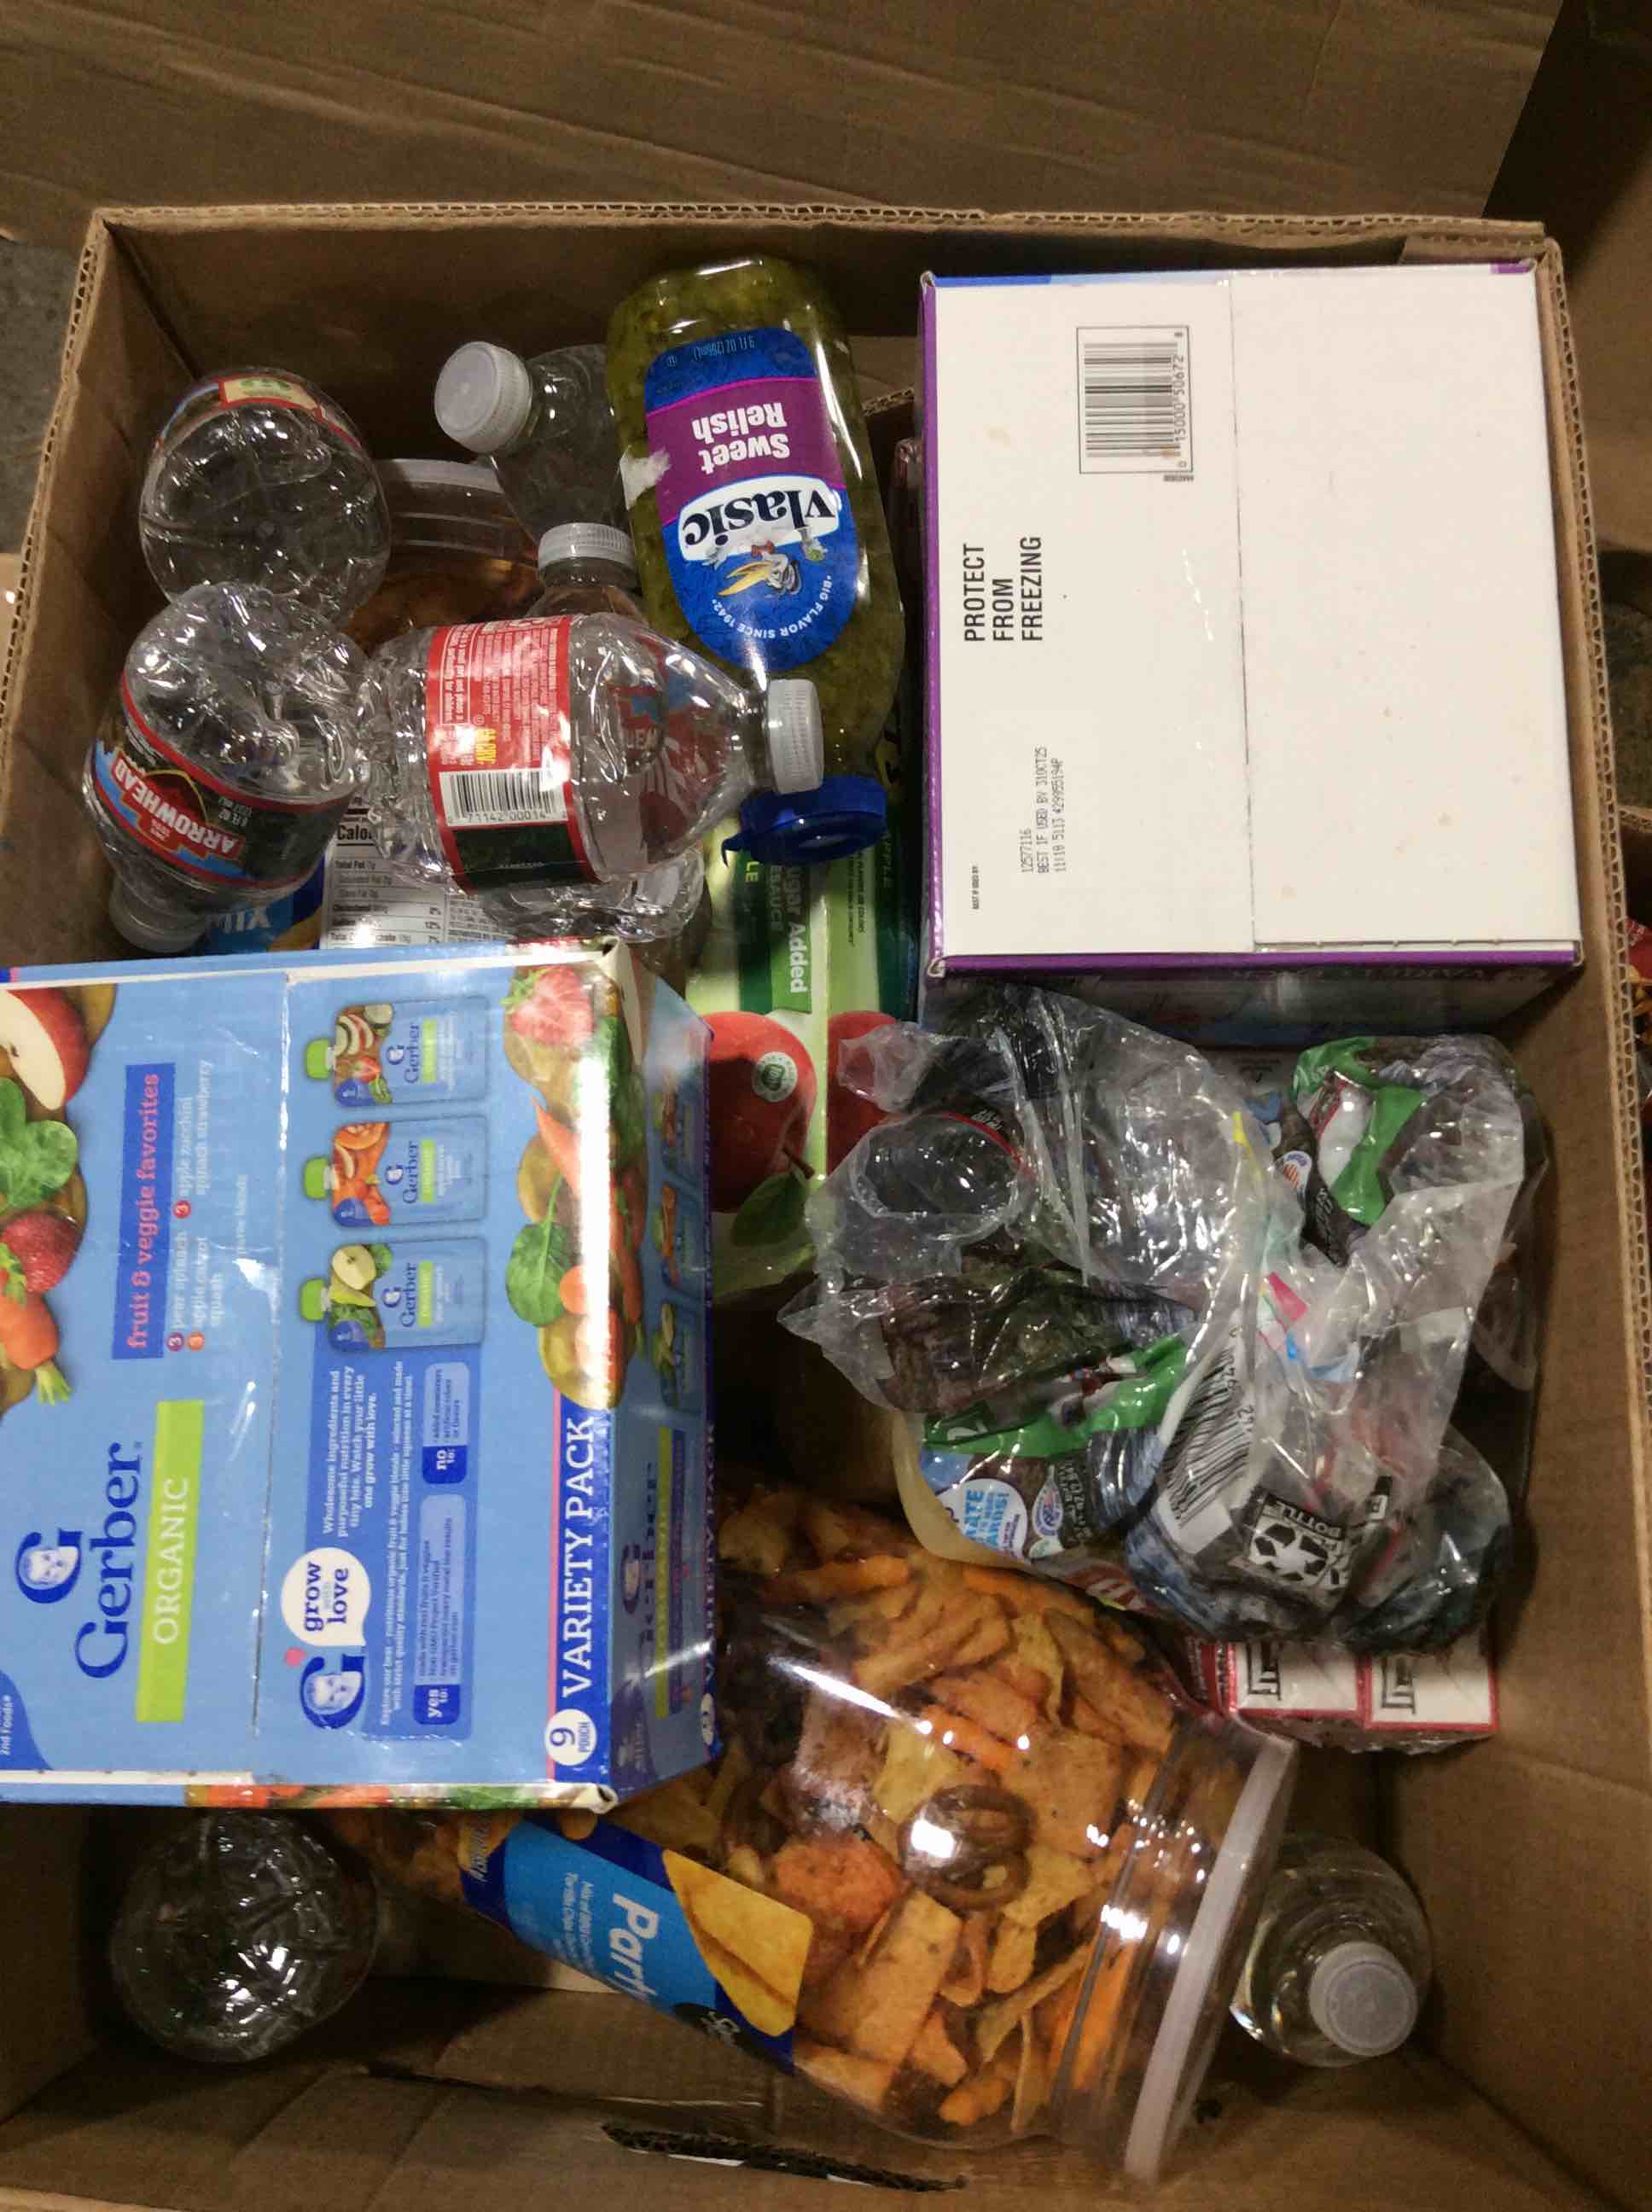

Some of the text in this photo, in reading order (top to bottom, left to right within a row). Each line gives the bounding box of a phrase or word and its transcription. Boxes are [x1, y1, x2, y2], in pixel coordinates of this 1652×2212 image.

[1172, 354, 1185, 396] 50672
[691, 401, 788, 444] Relish
[1173, 402, 1186, 442] 15000
[698, 432, 791, 474] Sweet
[711, 579, 831, 639] BIG FLAVOR SINCE 1942
[963, 543, 986, 642] PROTECT
[992, 578, 1015, 642] FROM
[1020, 536, 1043, 642] FREEZING
[113, 758, 236, 854] ARROWHEAD
[1035, 790, 1049, 804] BY
[1035, 807, 1049, 830] USED
[1036, 833, 1049, 846] IF
[1051, 817, 1066, 841] 5113
[744, 860, 760, 883] LE
[1036, 851, 1050, 874] BEST
[770, 864, 783, 931] ESAUCE
[782, 864, 809, 992] ugar Added
[404, 1022, 421, 1085] Gerber
[194, 1059, 213, 1196] spinach strawberry
[176, 1097, 194, 1214] 3 apple zucchini
[401, 1140, 419, 1204] Gerber
[127, 1073, 160, 1349] fruit & veggie favorites
[169, 1231, 189, 1347] 3 pear spinach
[191, 1285, 209, 1328] apple
[209, 1272, 226, 1328] squash
[400, 1262, 417, 1328] Gerber
[190, 1336, 203, 1346] 3
[354, 1375, 365, 1402] little
[393, 1360, 404, 1387] made
[356, 1403, 365, 1433] your
[365, 1423, 376, 1450] with
[323, 1371, 340, 1535] Wholesome ingredients and
[336, 1365, 354, 1538] purposeful nutrition in every
[352, 1435, 364, 1473] Watch
[366, 1452, 376, 1484] grow
[435, 1449, 448, 1470] no
[351, 1503, 363, 1528] tiny
[364, 1486, 374, 1508] one
[73, 1441, 142, 1679] Gerber
[152, 1477, 189, 1644] ORGANIC
[561, 1416, 596, 1698] VARIETY PACK
[303, 1561, 324, 1633] grow
[330, 1567, 349, 1625] love
[427, 1689, 443, 1718] yes
[548, 1726, 575, 1748] 9
[577, 1720, 591, 1754] POUCH
